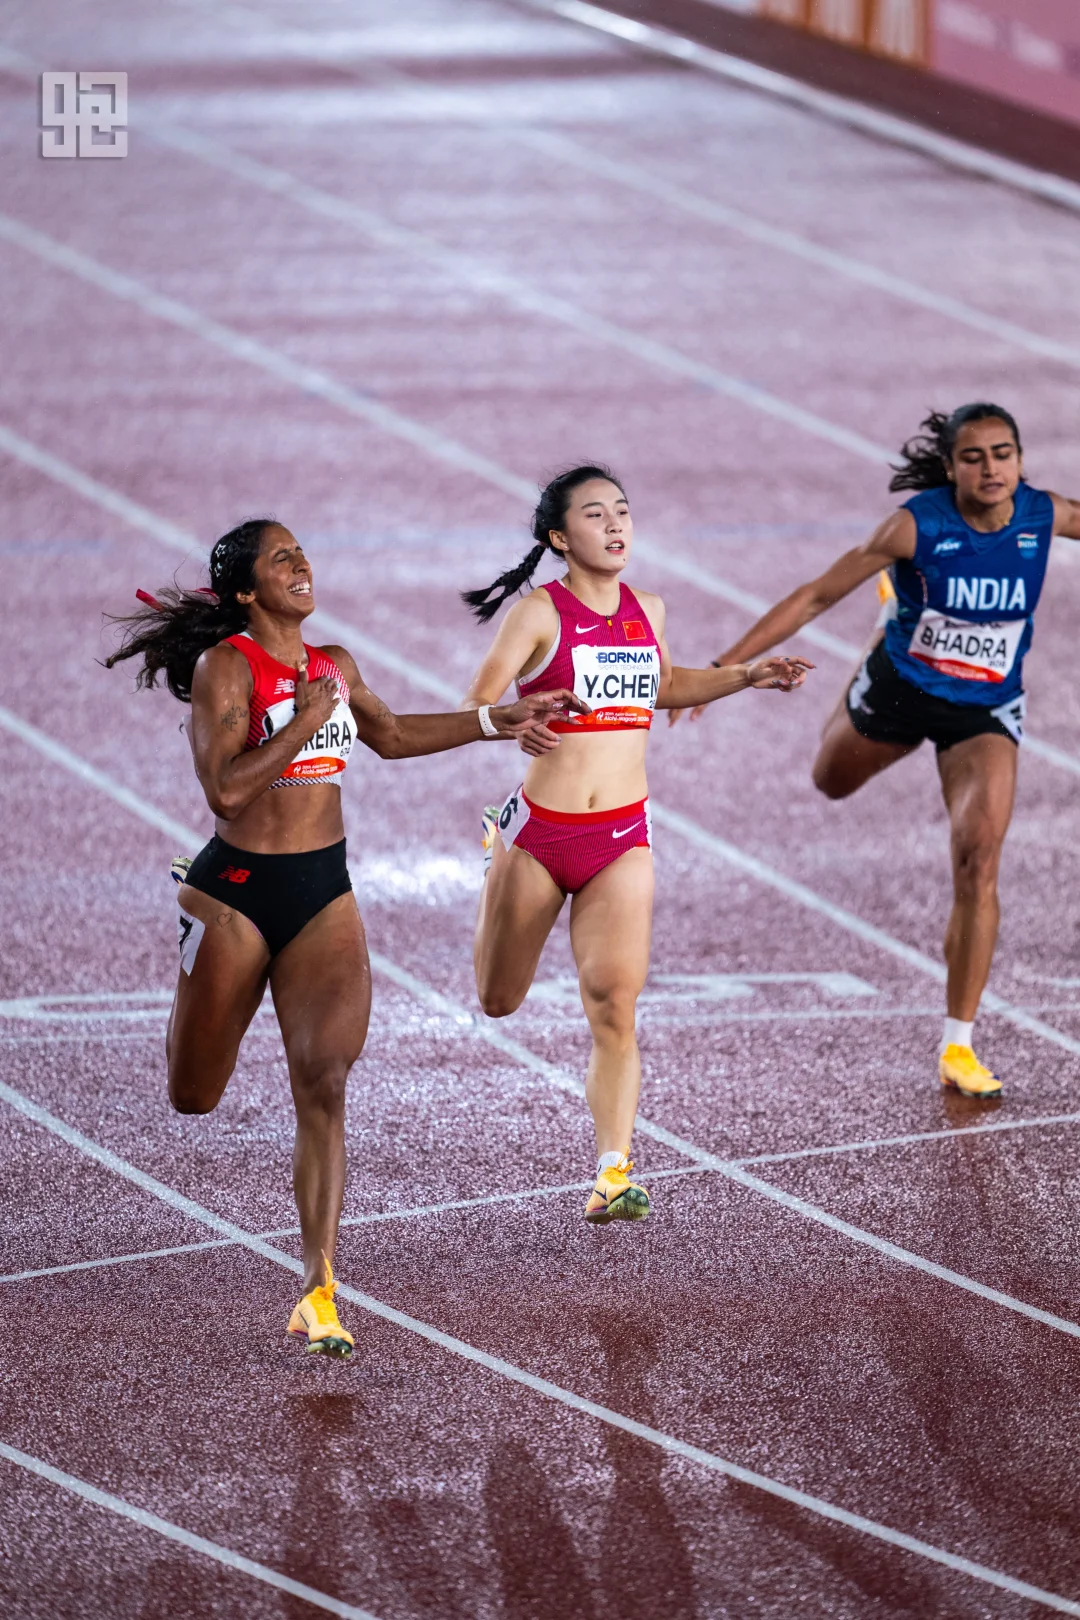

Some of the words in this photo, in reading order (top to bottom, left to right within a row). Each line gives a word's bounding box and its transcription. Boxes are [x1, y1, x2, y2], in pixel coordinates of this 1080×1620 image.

[946, 577, 1026, 611] INDIA
[920, 626, 1007, 659] BHADRA
[597, 652, 653, 664] BORNAN
[583, 673, 659, 699] Y.CHEN
